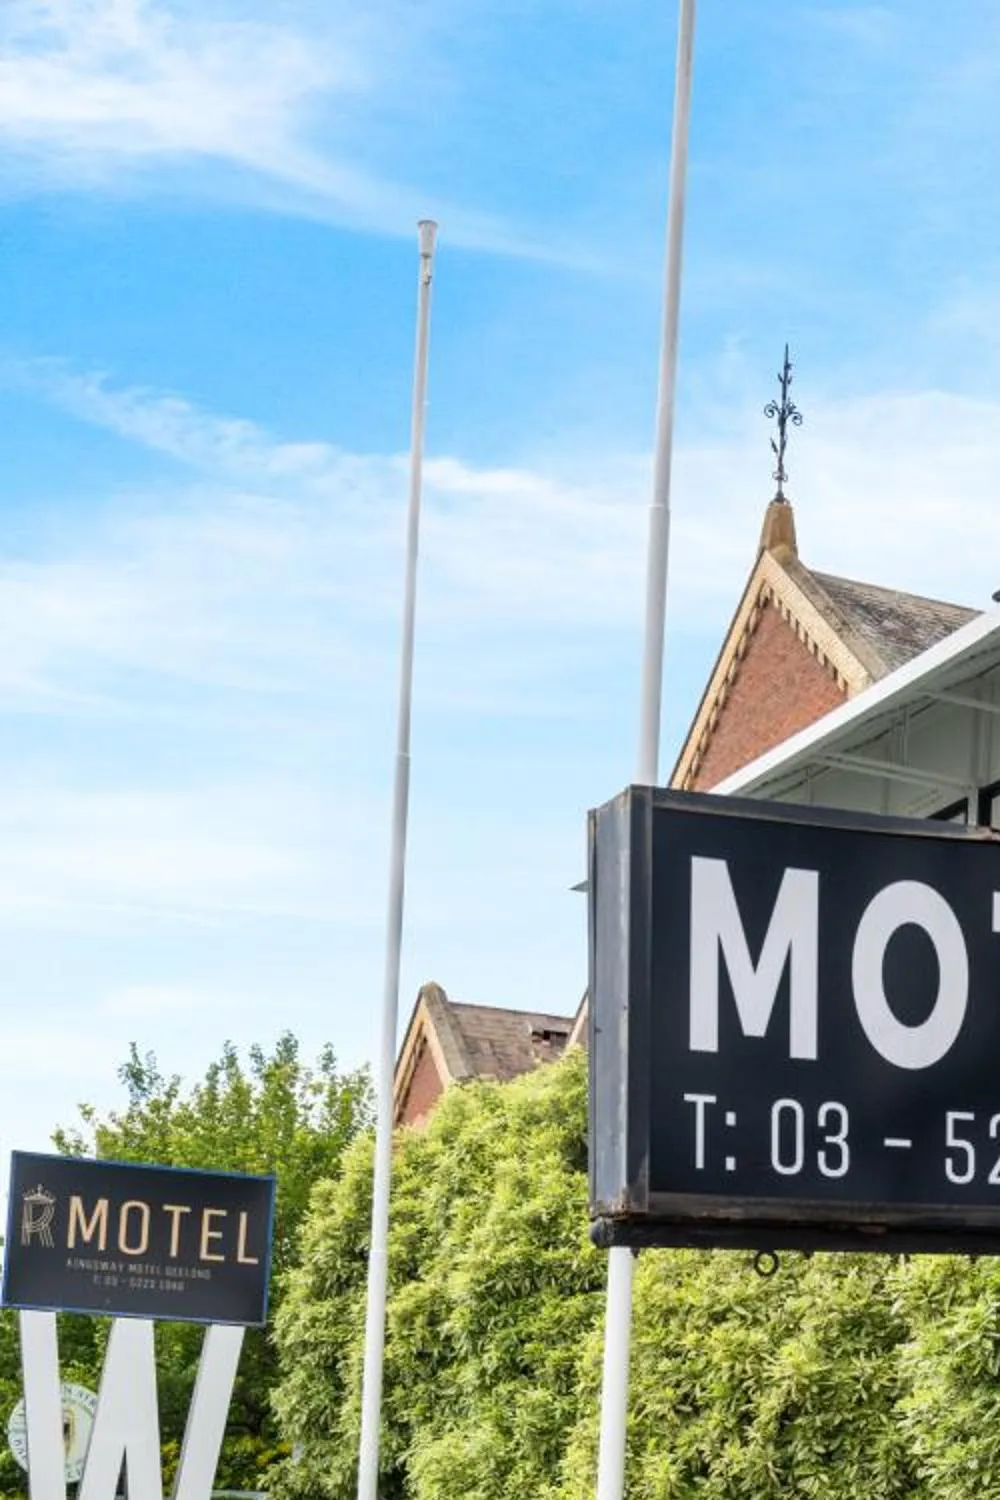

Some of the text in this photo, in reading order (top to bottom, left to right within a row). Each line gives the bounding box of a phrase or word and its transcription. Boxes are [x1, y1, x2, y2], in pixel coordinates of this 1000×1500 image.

[683, 1094, 737, 1171] T:
[770, 1098, 851, 1178] 03
[883, 1137, 912, 1150] -
[66, 1195, 259, 1265] MOTEL
